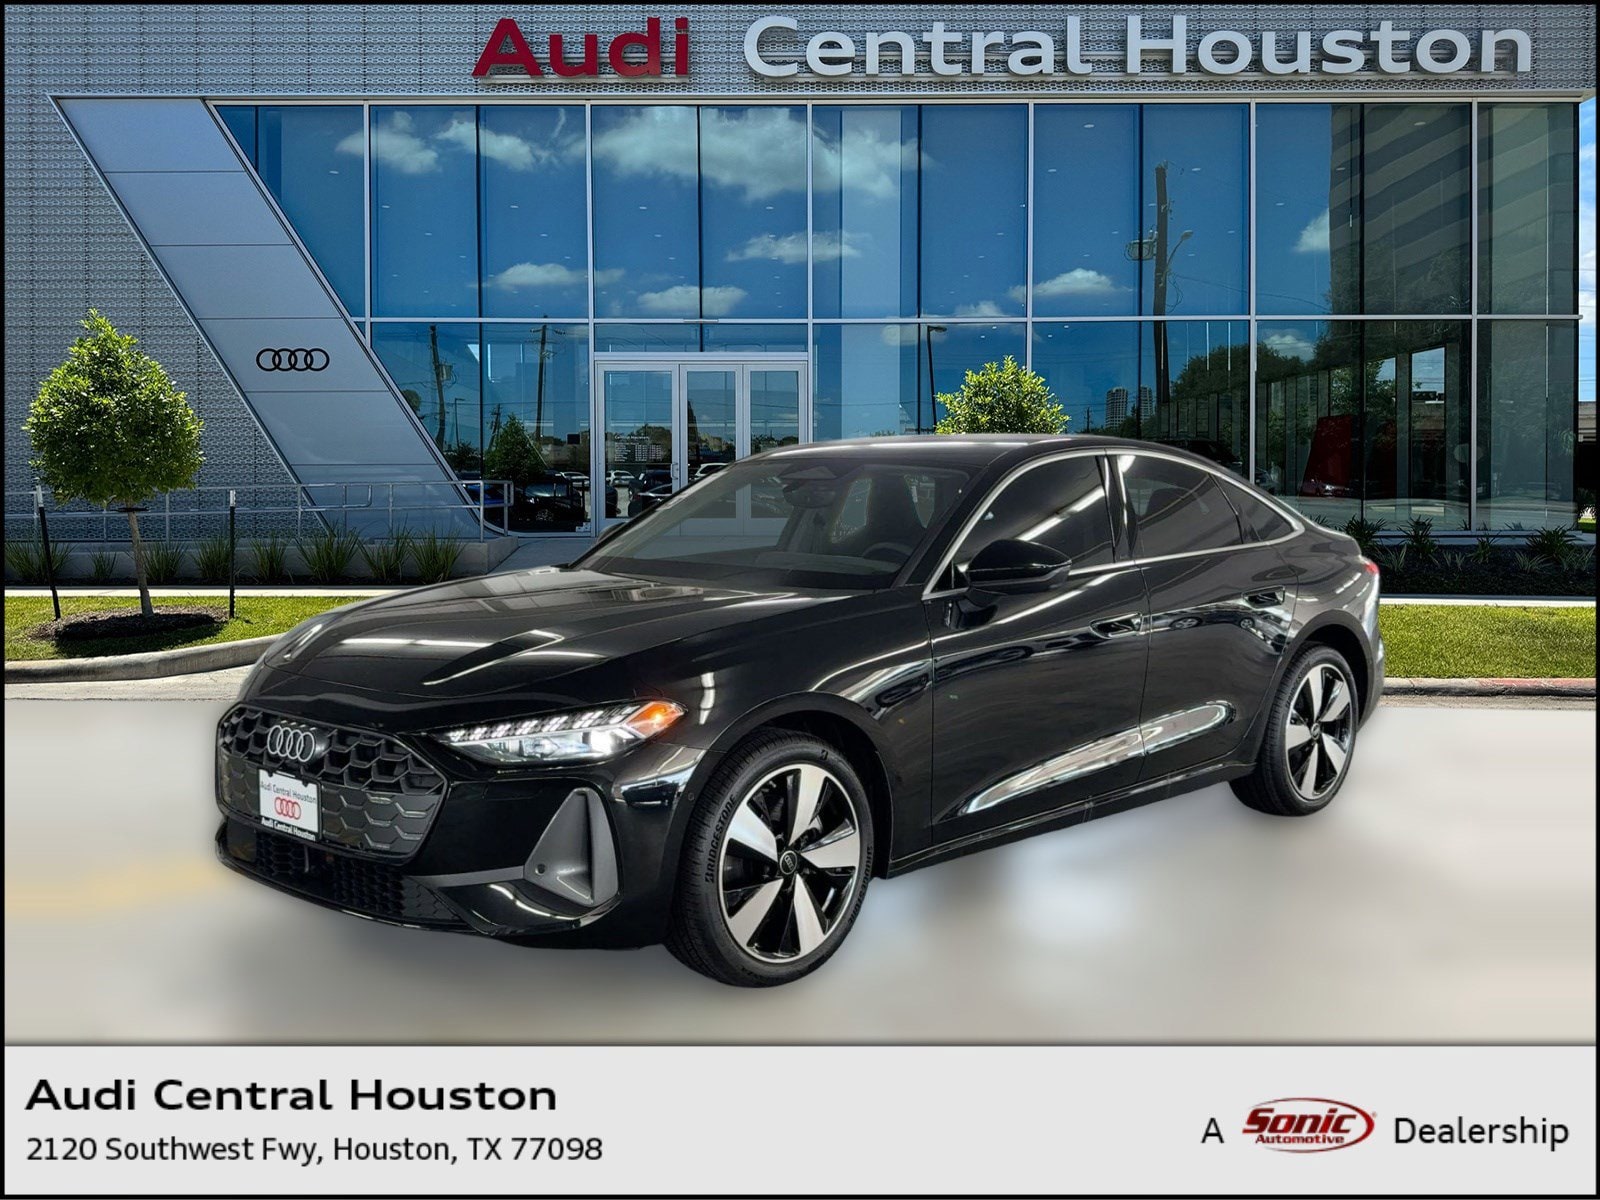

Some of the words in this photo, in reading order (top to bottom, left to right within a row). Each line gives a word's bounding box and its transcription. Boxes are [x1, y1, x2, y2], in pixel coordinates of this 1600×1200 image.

[472, 17, 689, 77] Audi
[744, 15, 1093, 77] Central
[1126, 15, 1532, 75] Houston
[273, 784, 292, 797] Central
[274, 820, 293, 835] Central
[704, 794, 736, 883] BRIDGESTONE
